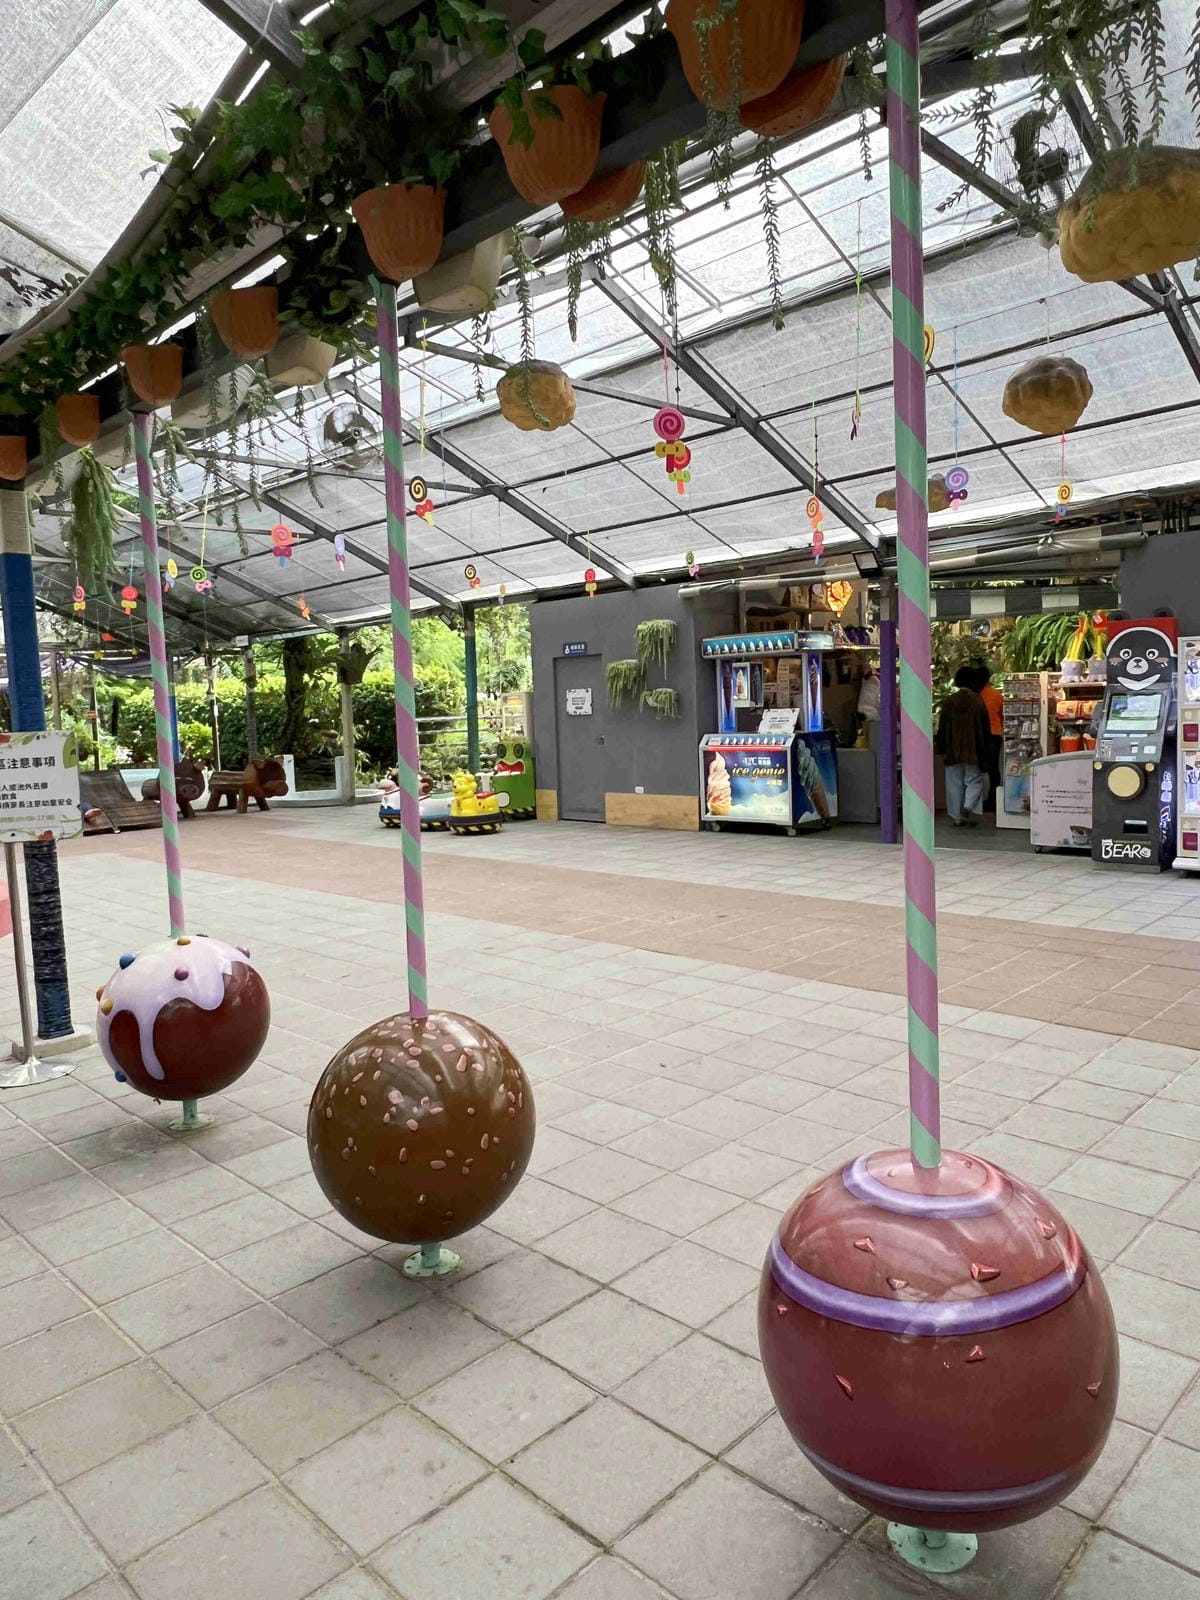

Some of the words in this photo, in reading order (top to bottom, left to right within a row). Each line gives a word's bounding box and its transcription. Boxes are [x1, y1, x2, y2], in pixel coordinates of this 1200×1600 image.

[732, 763, 750, 775] ice
[751, 763, 785, 783] genie
[0, 792, 17, 800] 飲食
[1101, 840, 1142, 859] BEAR
